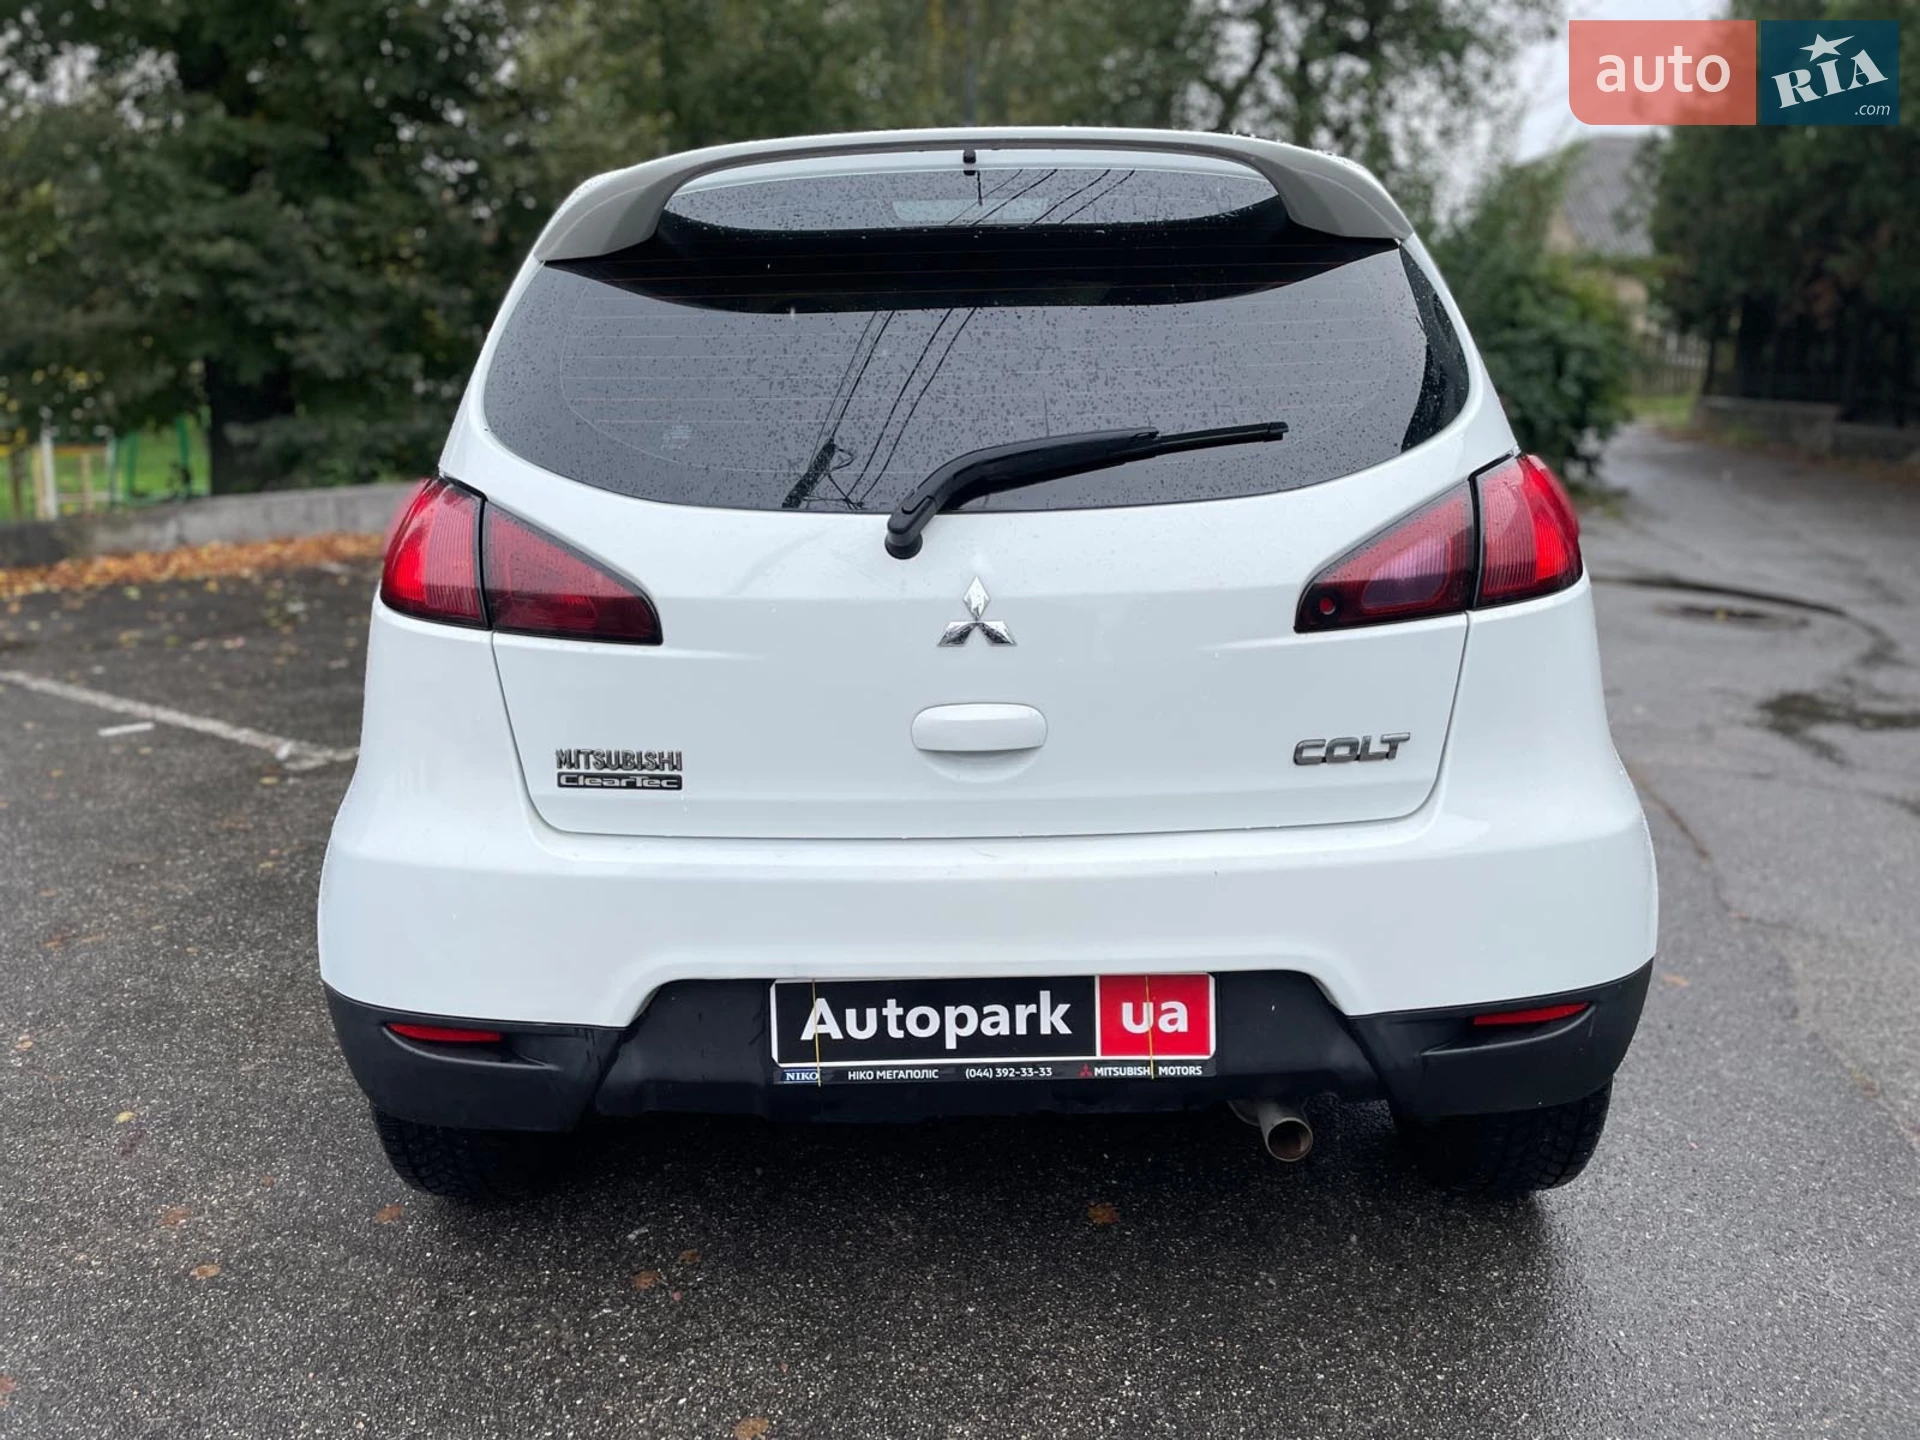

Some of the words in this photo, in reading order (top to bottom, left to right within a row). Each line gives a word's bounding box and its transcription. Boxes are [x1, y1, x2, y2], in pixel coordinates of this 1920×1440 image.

[1293, 732, 1411, 766] COLT
[555, 748, 683, 771] MITSUBISHI
[559, 774, 680, 788] ClearTec
[800, 989, 1073, 1050] Autopark
[1121, 999, 1190, 1035] ua
[785, 1071, 819, 1081] NIKO
[848, 1070, 874, 1081] НІКО
[876, 1068, 940, 1080] МЕГАПОЛІС
[965, 1067, 994, 1080] (044)
[995, 1066, 1053, 1079] 392-33-33
[1093, 1066, 1154, 1077] MITSUBISH
[1158, 1065, 1203, 1076] MOTORS
